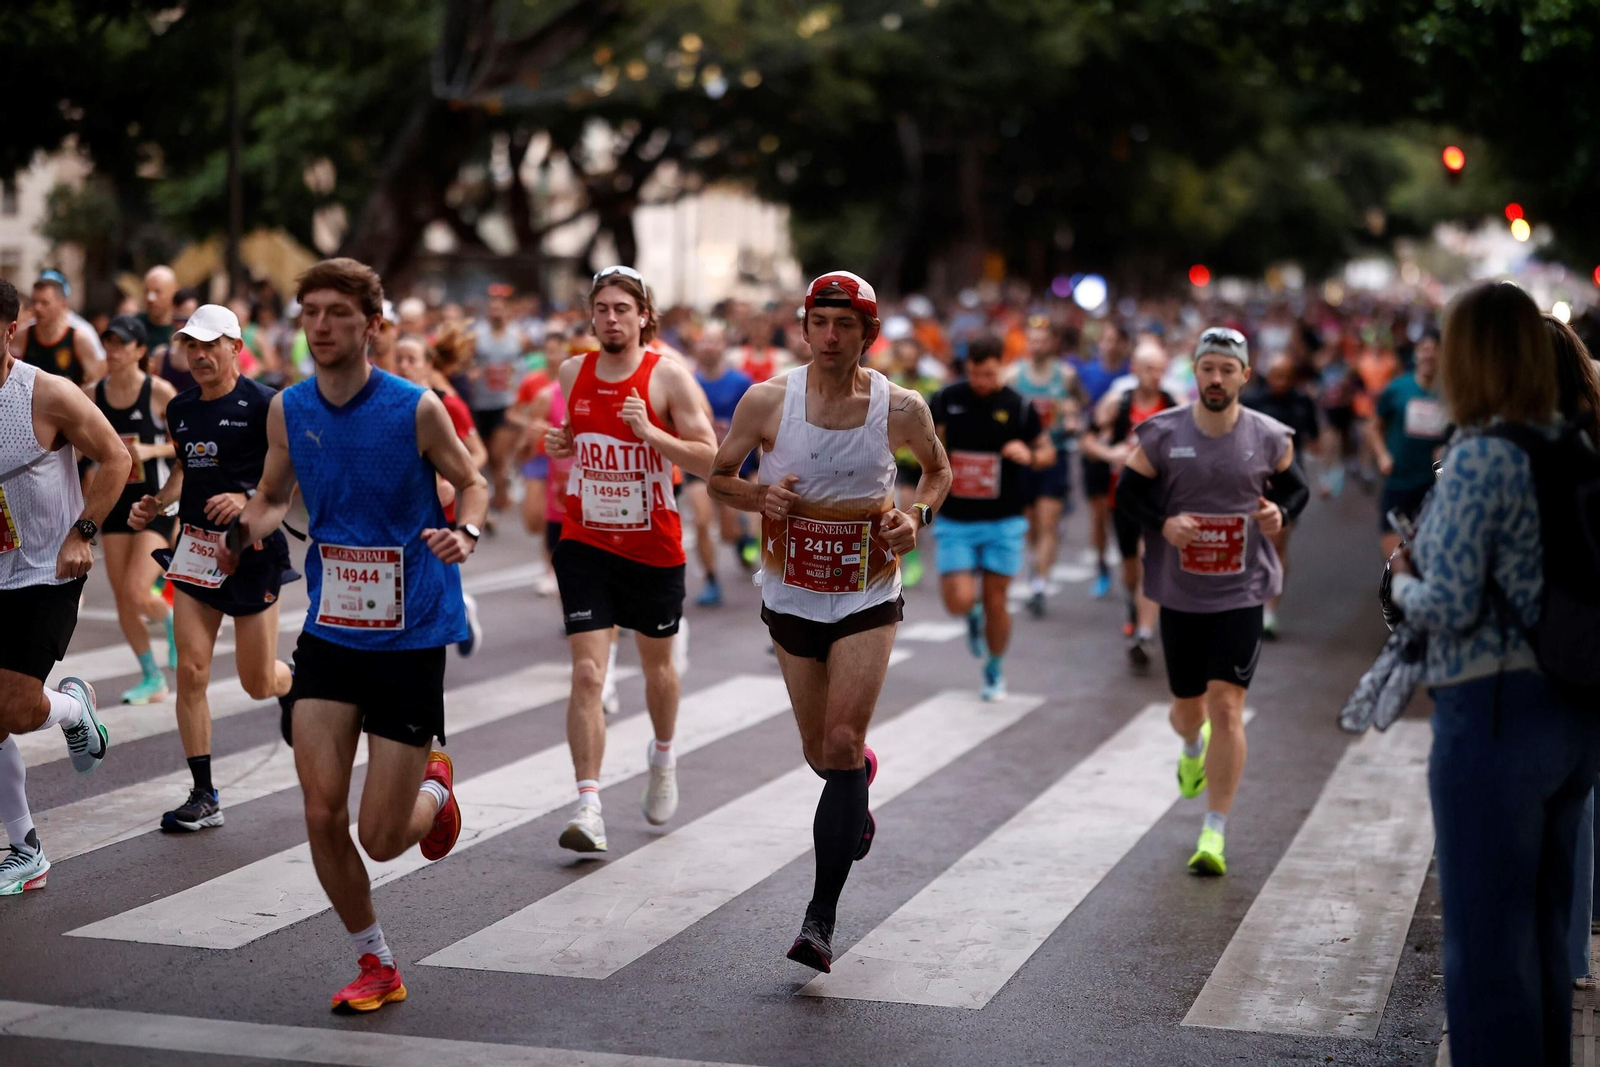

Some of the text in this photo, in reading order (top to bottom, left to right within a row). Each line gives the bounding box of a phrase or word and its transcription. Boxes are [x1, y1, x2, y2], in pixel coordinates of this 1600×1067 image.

[185, 441, 218, 458] 200
[574, 441, 663, 474] ARATÓN
[592, 484, 630, 497] 14945
[807, 522, 857, 535] GENERALI
[804, 537, 843, 554] 2416
[338, 549, 388, 562] GENERALI
[336, 566, 379, 584] 14944
